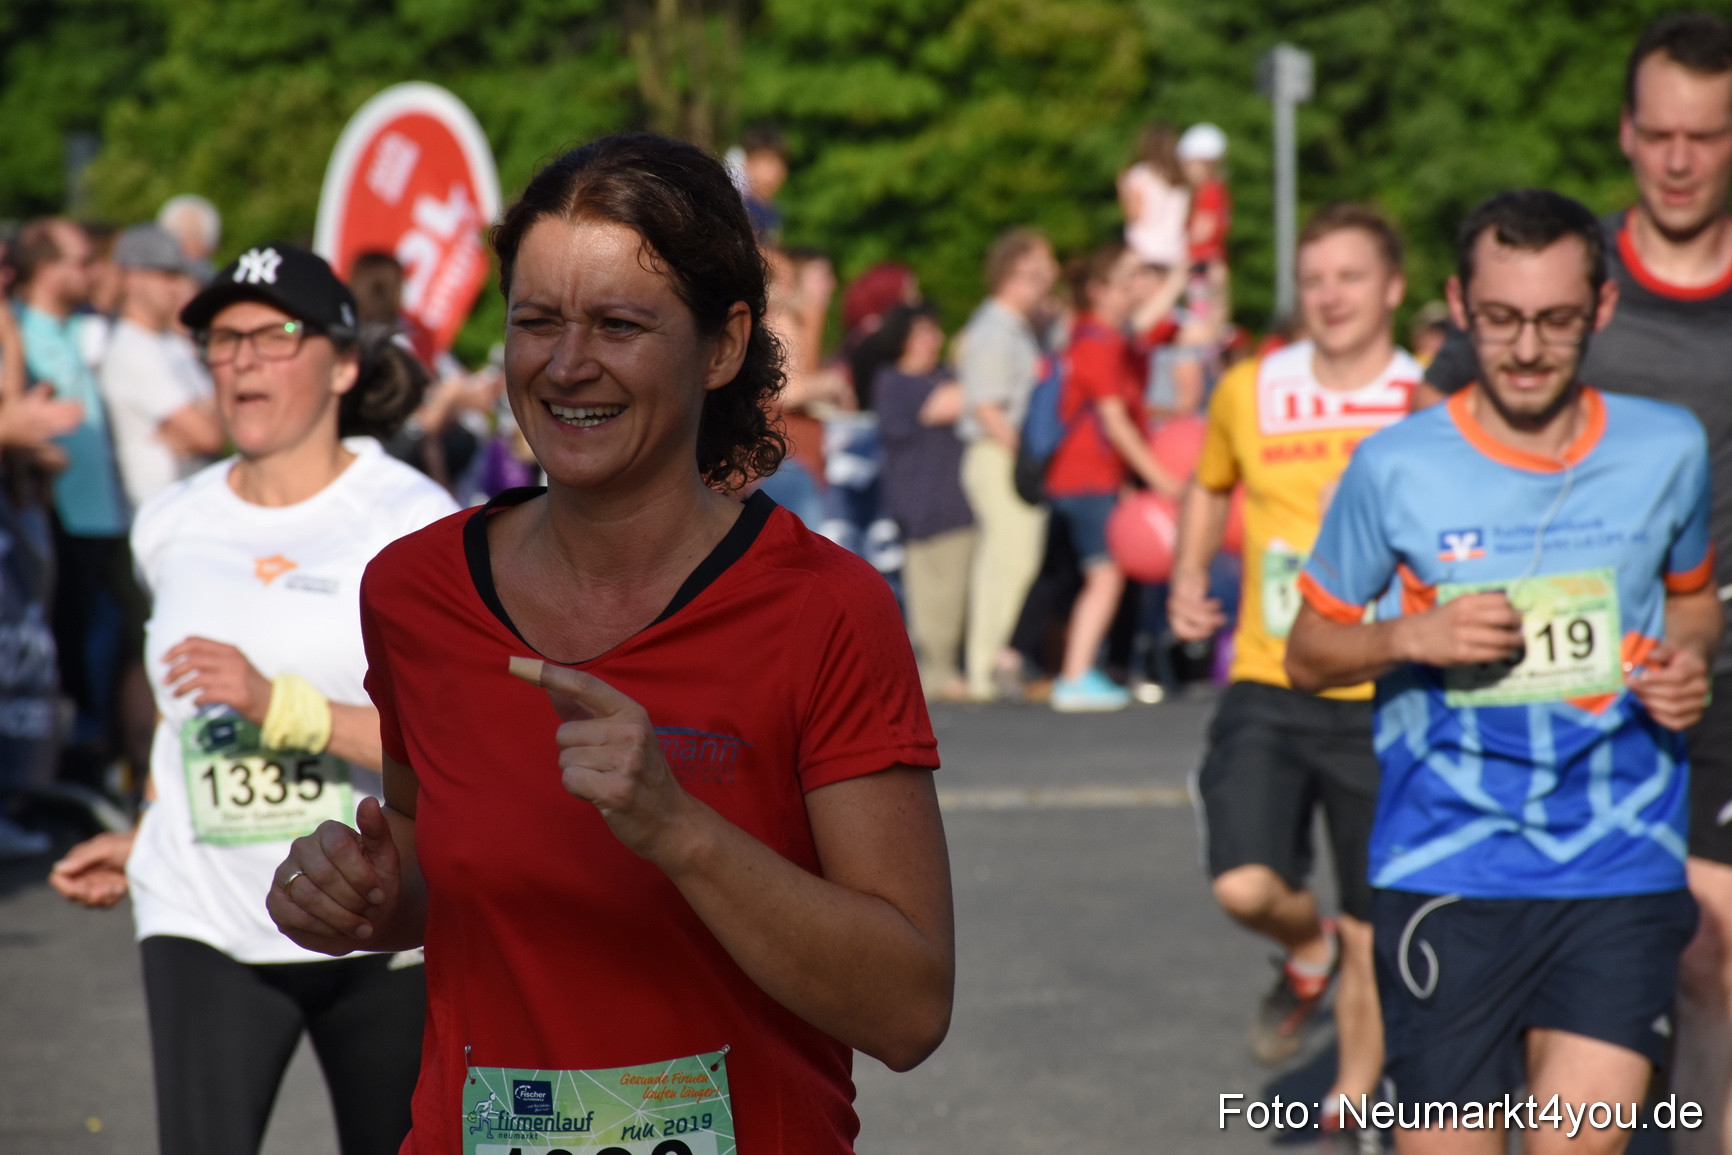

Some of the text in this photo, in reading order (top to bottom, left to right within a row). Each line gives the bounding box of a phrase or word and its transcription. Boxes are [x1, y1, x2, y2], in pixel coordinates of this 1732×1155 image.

[233, 247, 283, 284] NY
[659, 738, 739, 762] mann
[202, 759, 324, 808] 1335
[620, 1072, 708, 1086] Gesunde Firmen
[520, 1090, 546, 1098] Fischer
[643, 1083, 721, 1104] laufen länger!
[498, 1110, 595, 1132] firmenlauf
[662, 1113, 713, 1136] 2019
[498, 1133, 538, 1141] neumarkt
